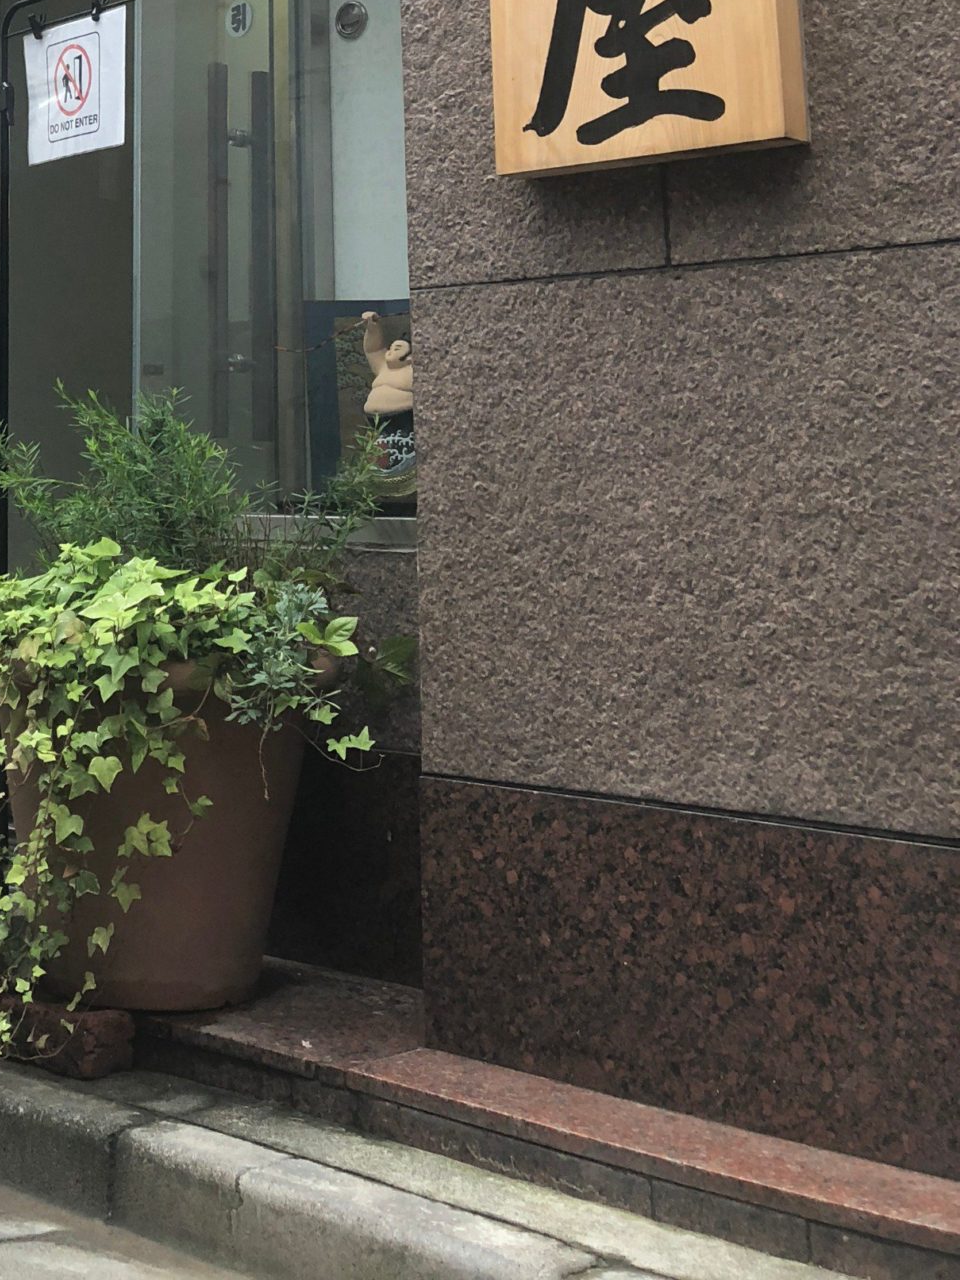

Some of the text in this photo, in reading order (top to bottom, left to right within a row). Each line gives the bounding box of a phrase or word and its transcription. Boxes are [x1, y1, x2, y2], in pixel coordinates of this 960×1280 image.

[231, 2, 247, 33] 引
[49, 114, 98, 135] DO NOT ENTER
